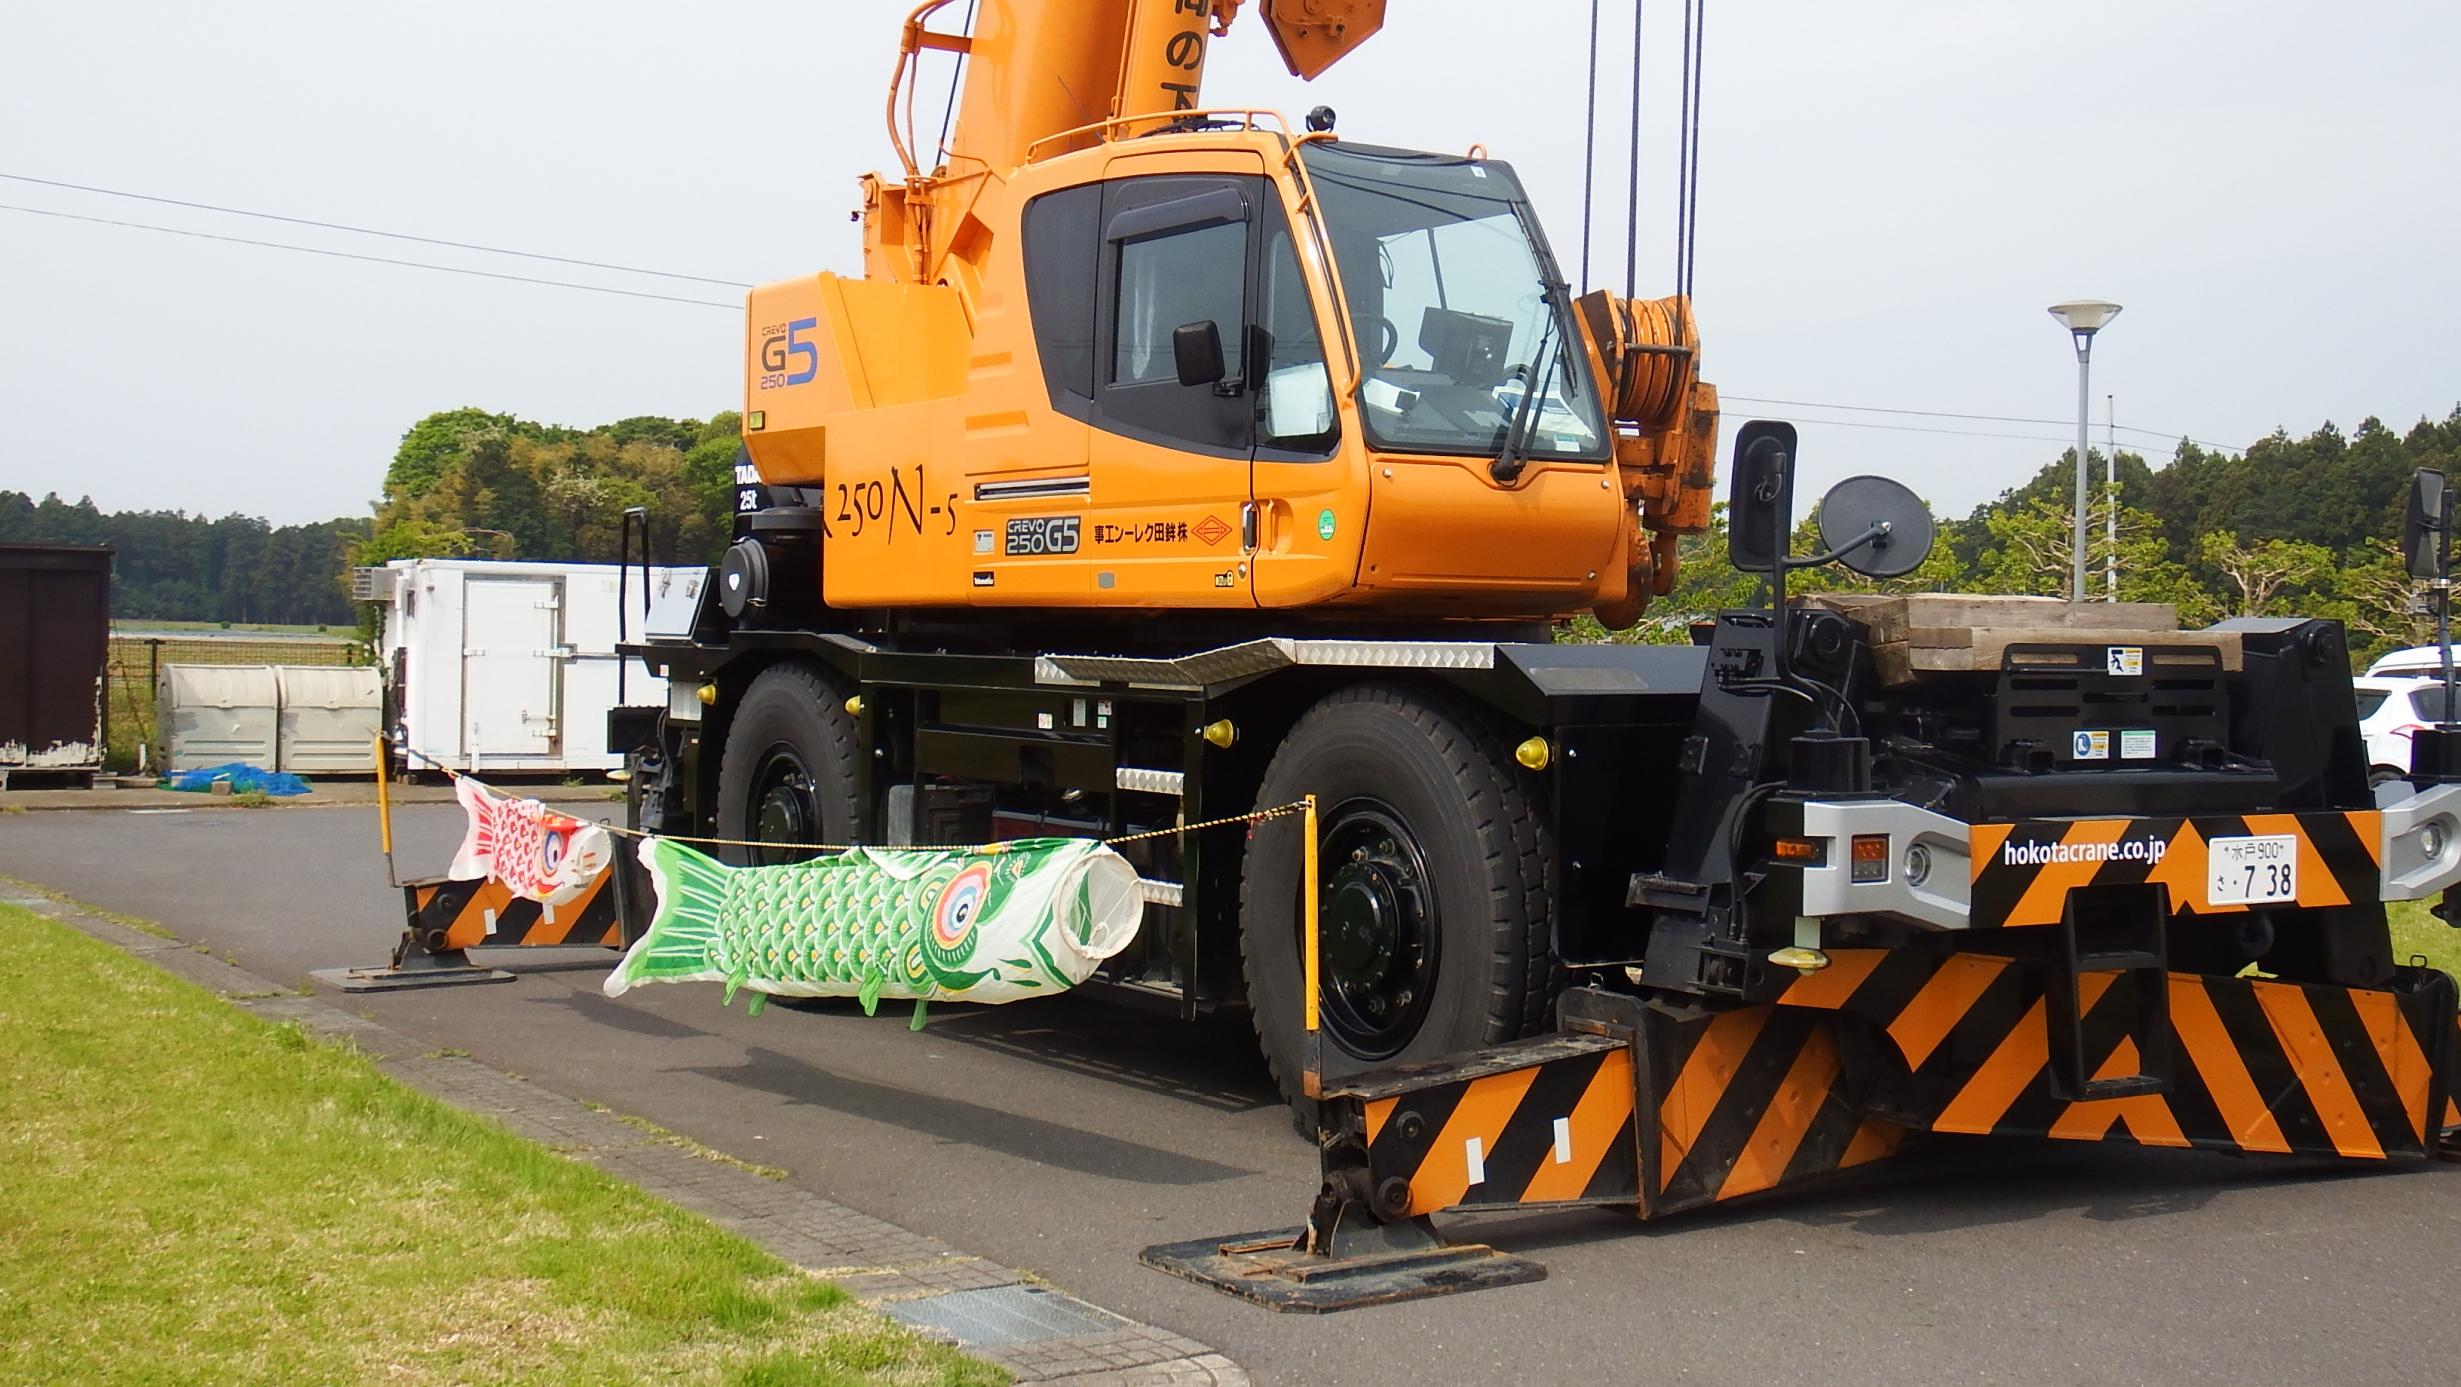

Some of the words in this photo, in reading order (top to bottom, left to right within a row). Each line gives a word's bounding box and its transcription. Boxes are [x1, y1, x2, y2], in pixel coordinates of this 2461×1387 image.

[762, 323, 787, 336] CREVO
[761, 373, 785, 390] 250
[740, 490, 757, 510] 25t
[1007, 519, 1045, 533] CREVO
[1046, 518, 1079, 552] G5
[1007, 534, 1044, 553] 250
[2004, 835, 2166, 865] hokotacrane.co.jp
